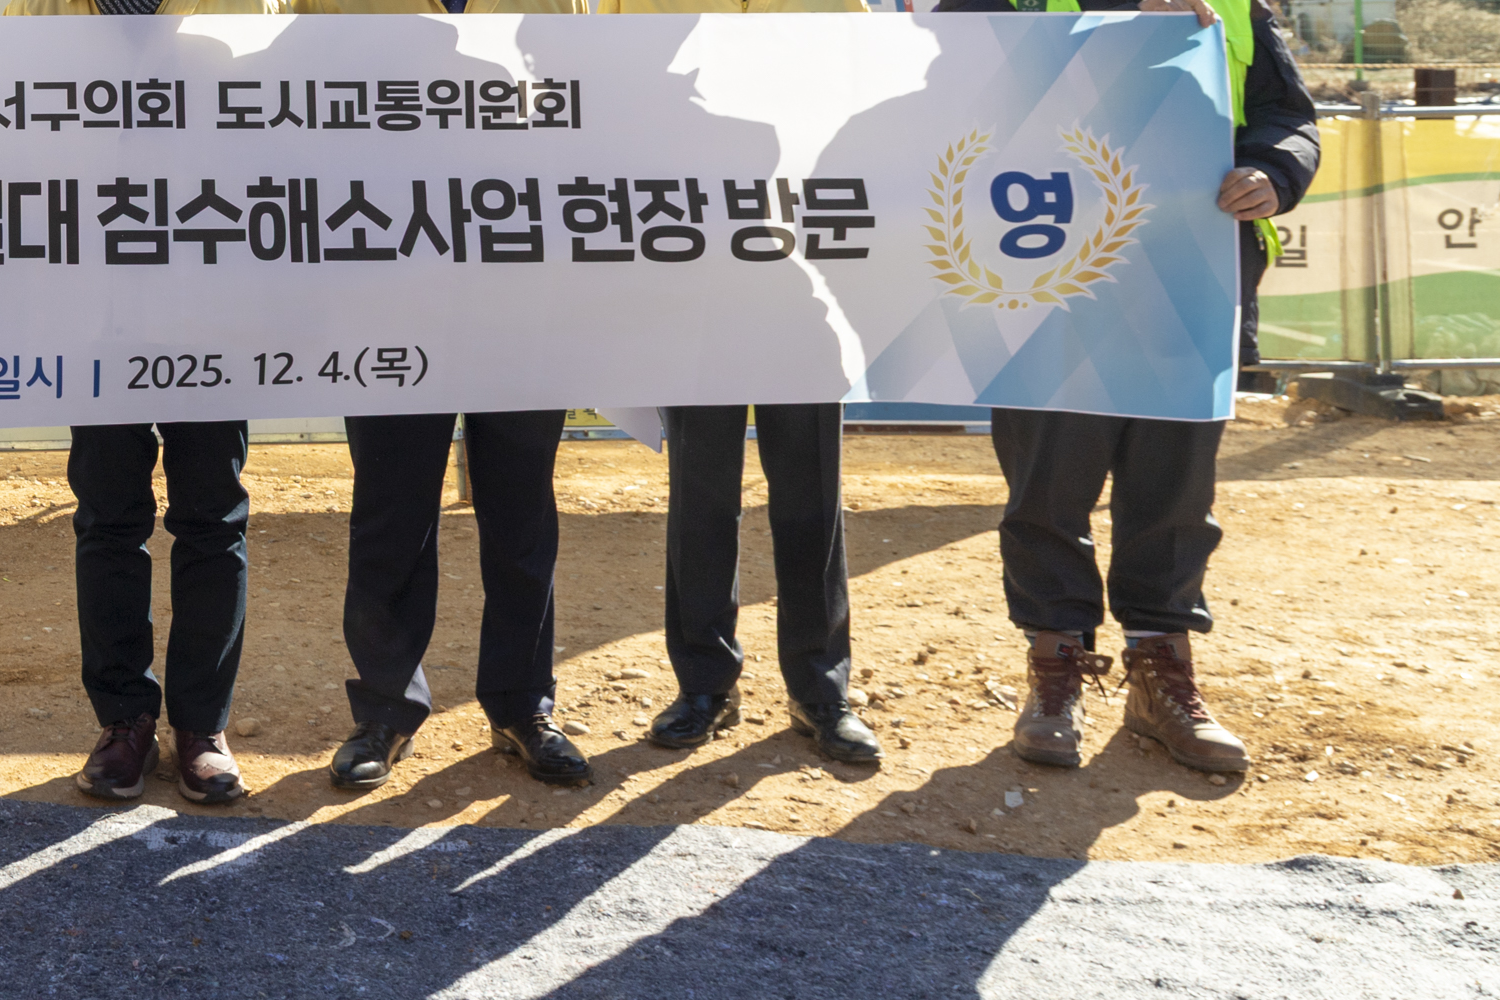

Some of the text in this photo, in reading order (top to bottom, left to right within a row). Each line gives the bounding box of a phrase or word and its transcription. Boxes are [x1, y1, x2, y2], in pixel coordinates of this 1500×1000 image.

[215, 77, 582, 132] 도시교통위원회
[96, 175, 546, 266] 침수해소사업
[557, 174, 709, 264] 현장
[725, 176, 876, 262] 방문
[988, 170, 1074, 260] 영
[1437, 207, 1482, 249] 안
[127, 352, 232, 390] 2025.
[253, 351, 304, 386] 12.
[316, 345, 430, 388] 4.(목)
